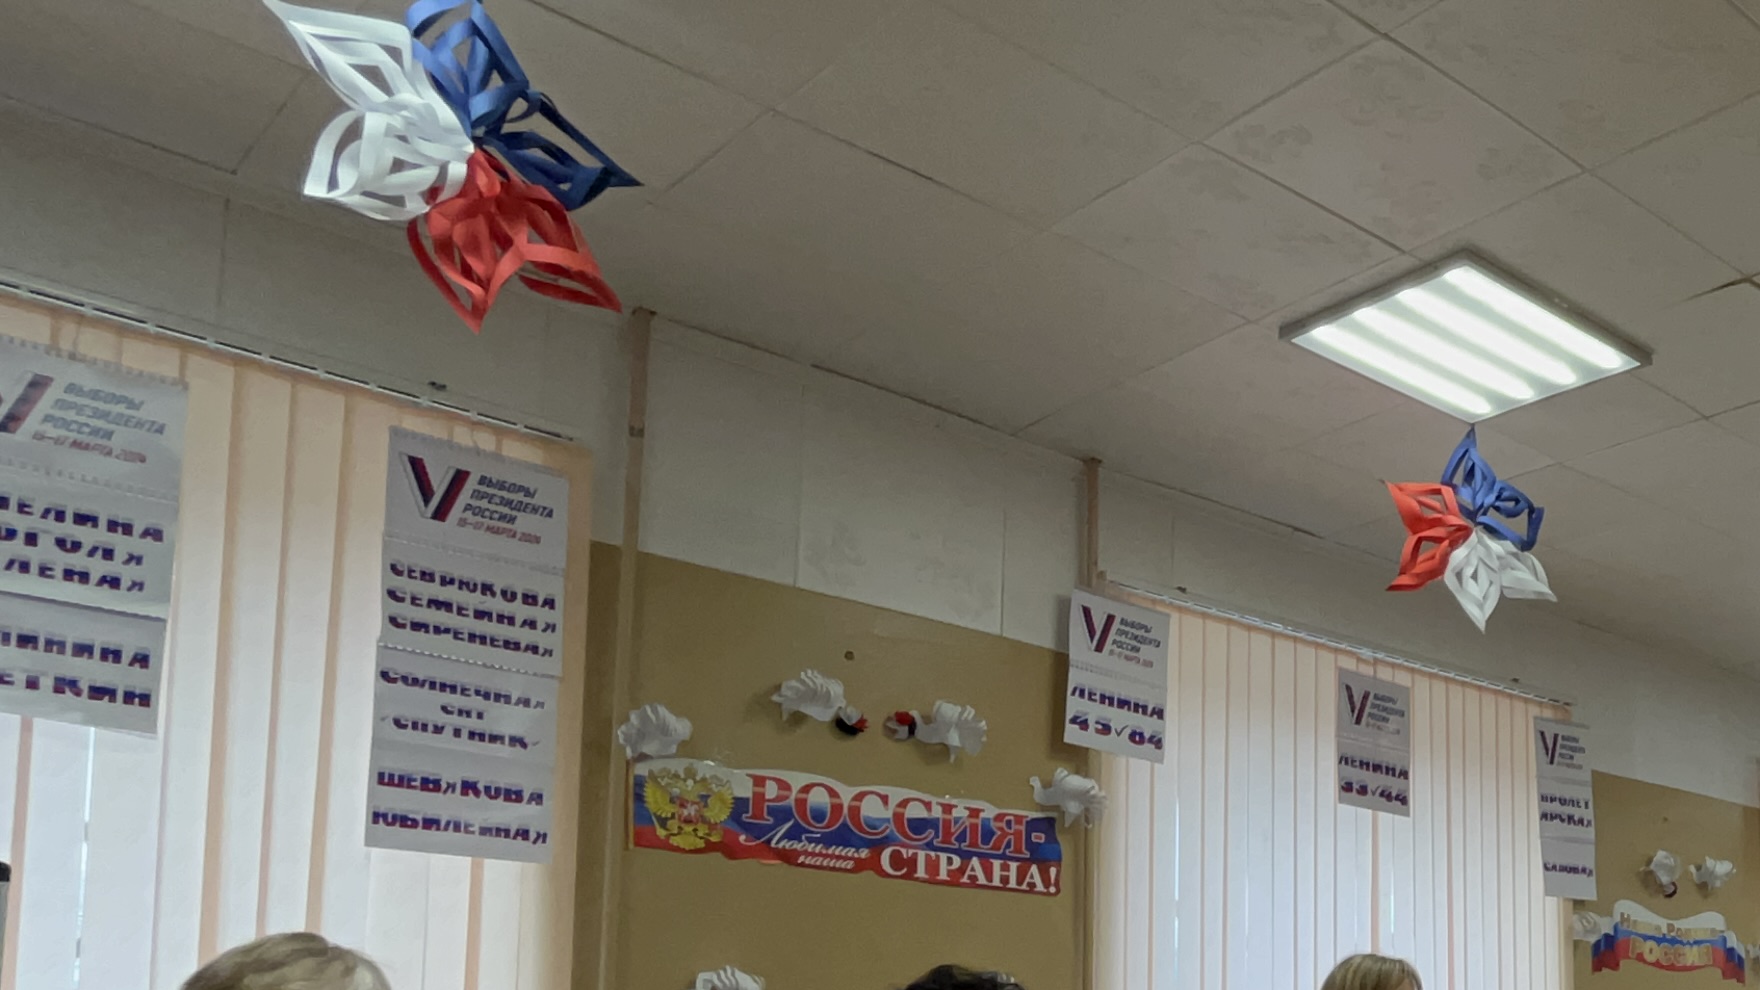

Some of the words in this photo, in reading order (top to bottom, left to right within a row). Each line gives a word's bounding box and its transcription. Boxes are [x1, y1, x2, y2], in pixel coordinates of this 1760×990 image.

[64, 382, 144, 411] ВЫБОРЫ
[41, 414, 115, 441] РОССИИ
[51, 398, 166, 435] ПРЕЗИДЕНТА
[470, 489, 554, 519] ПРЕЗИДЕНТА
[477, 474, 537, 499] ВЫБОРЫ
[462, 503, 517, 526] РОССИИ
[389, 559, 557, 610] СЕВРЮКОВА
[388, 612, 553, 657] СИРЕНЕВАЯ
[379, 667, 545, 709] СОЛНЕЧНАЯ
[1070, 682, 1164, 721] ЛЕНИНА
[1339, 752, 1409, 780] ЛЕНИНА
[377, 768, 543, 806] ШЕВЯКОВА
[739, 819, 870, 858] Любимая
[797, 854, 854, 870] наша
[880, 846, 1057, 893] СТРАНА!
